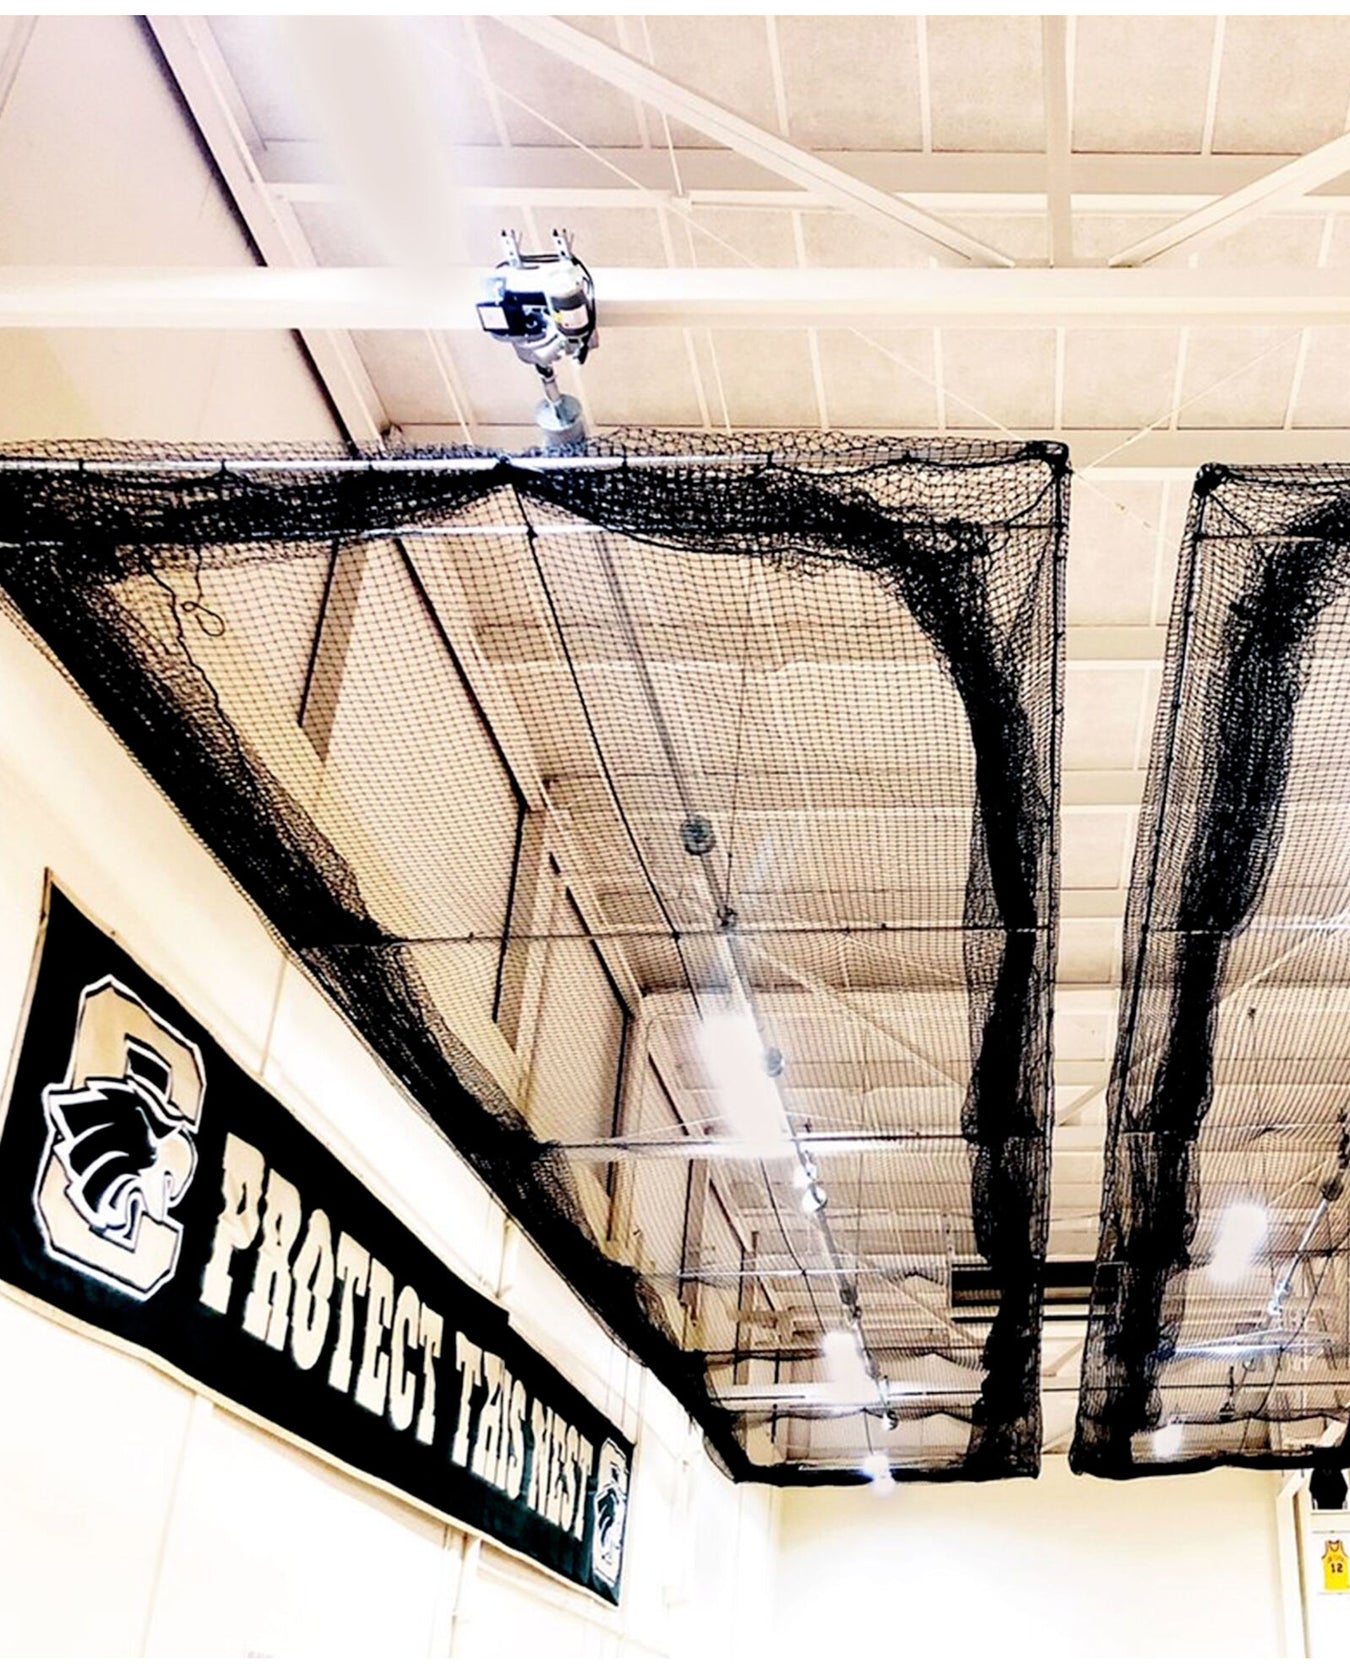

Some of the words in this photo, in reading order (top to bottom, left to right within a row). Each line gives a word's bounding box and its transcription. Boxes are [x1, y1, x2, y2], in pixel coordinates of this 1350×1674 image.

[199, 1131, 444, 1446] PROTECT
[452, 1330, 527, 1501] THIS
[528, 1397, 594, 1543] NEST
[1330, 1562, 1344, 1574] 12
